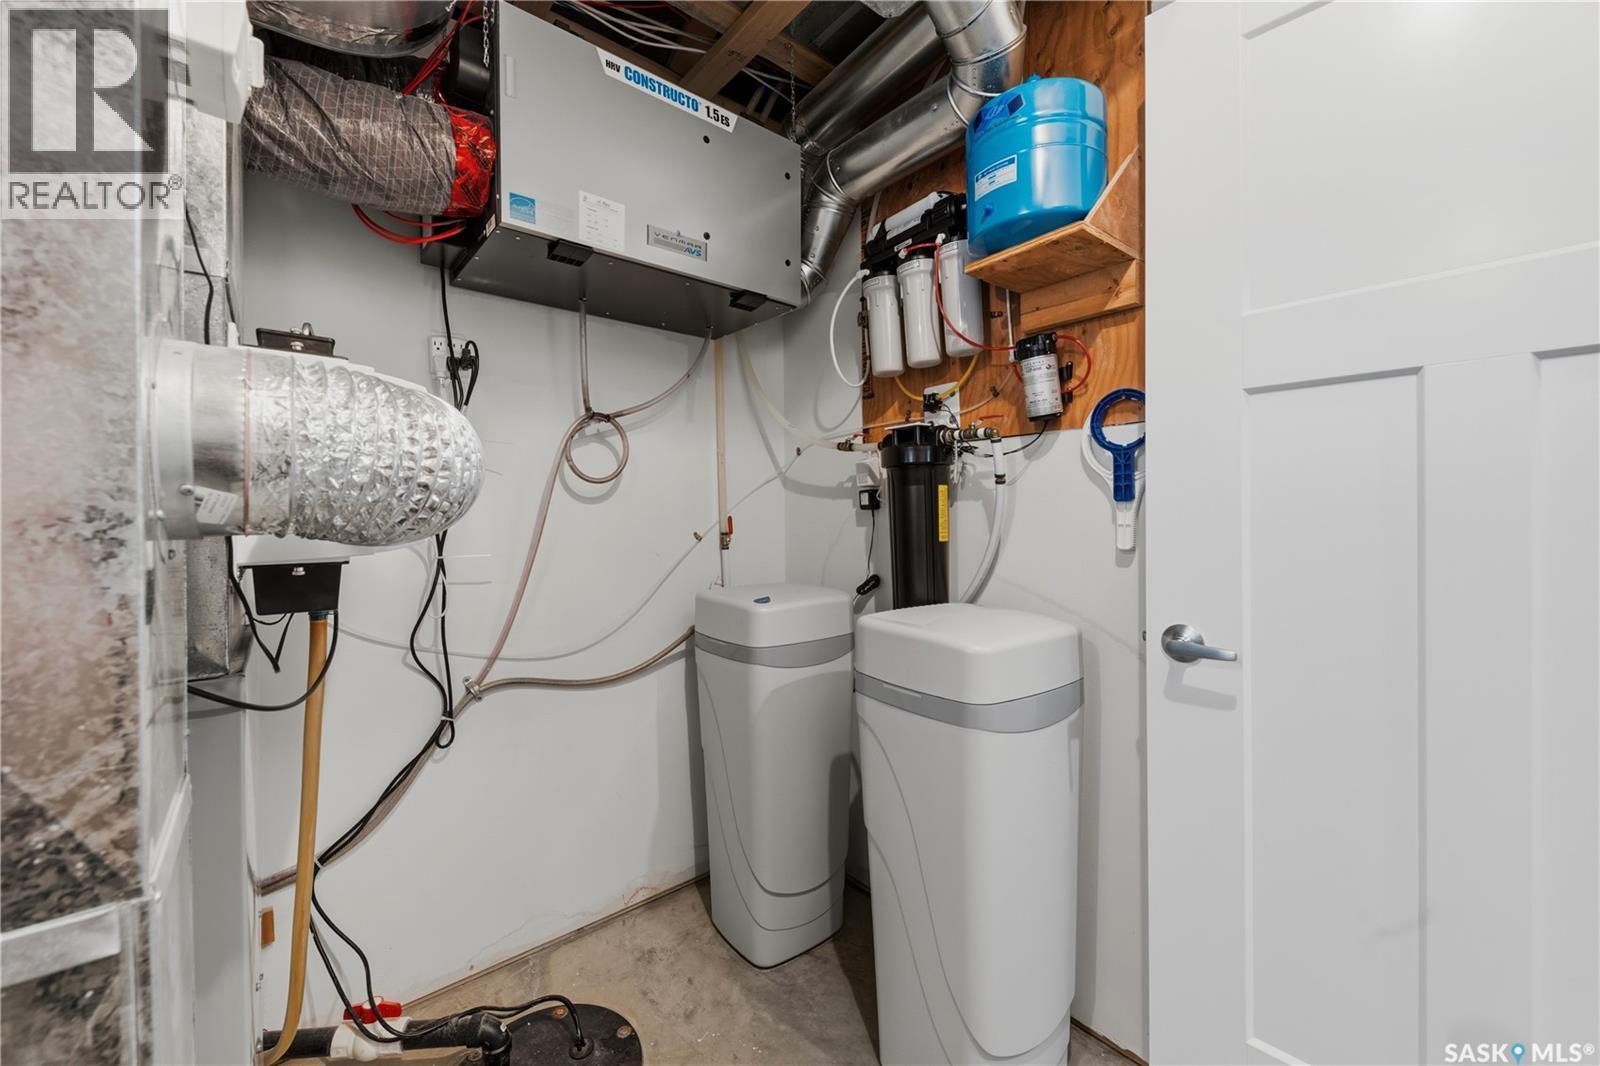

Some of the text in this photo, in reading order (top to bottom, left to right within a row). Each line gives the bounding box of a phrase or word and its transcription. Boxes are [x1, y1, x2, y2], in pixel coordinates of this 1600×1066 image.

[605, 59, 621, 73] HRV
[624, 65, 699, 113] CONSTRUCTO
[684, 246, 702, 257] AVS
